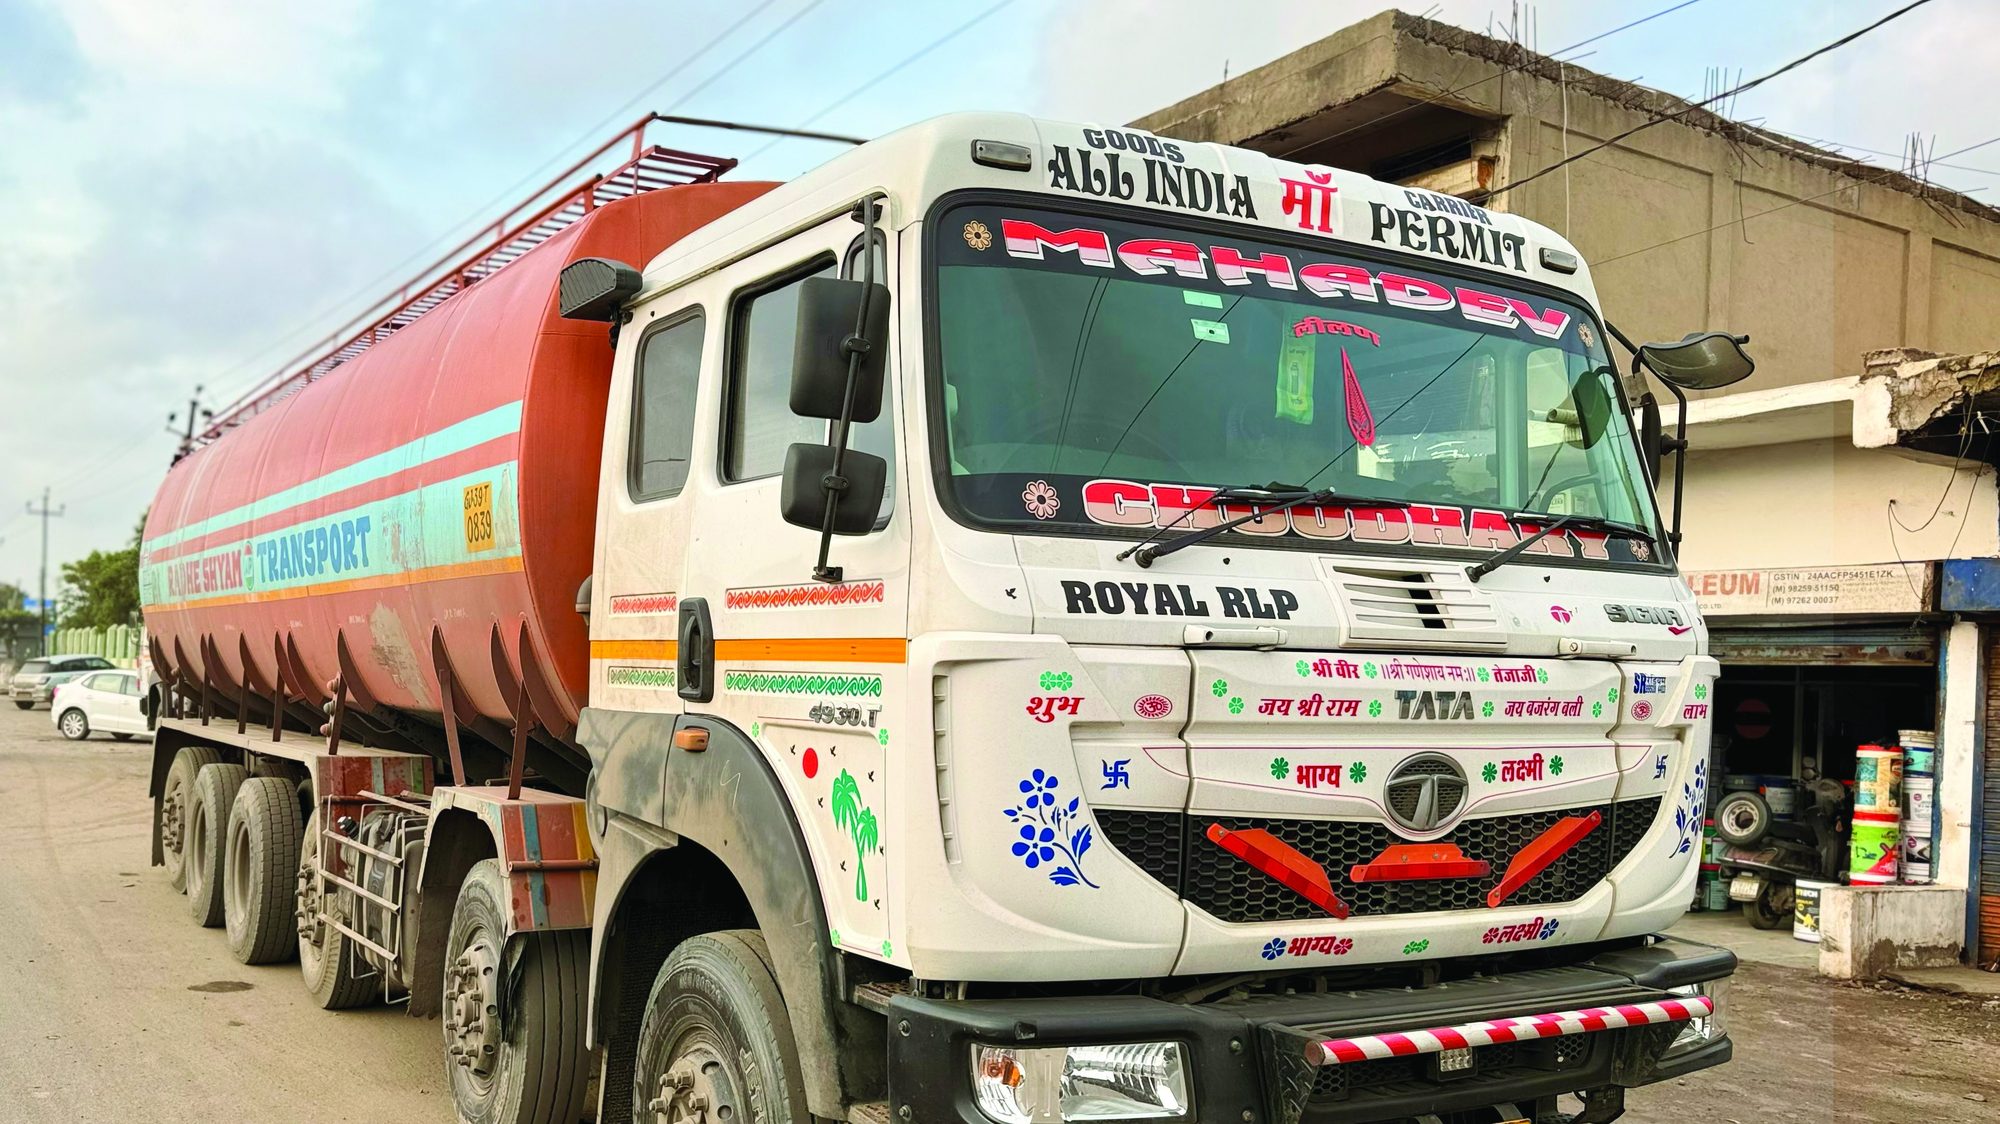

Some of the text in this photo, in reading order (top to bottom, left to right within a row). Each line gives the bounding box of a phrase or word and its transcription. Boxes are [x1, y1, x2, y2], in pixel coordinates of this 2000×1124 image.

[1083, 128, 1185, 163] GOODS
[1048, 144, 1258, 221] ALL INDIA
[1403, 190, 1493, 226] CARRIER
[1369, 201, 1528, 273] PERMIT
[1001, 218, 1571, 340] MAHADEV
[467, 510, 492, 543] 0839
[1081, 479, 1611, 561] CHOUDHARY
[256, 515, 372, 584] TRANSPORT
[168, 559, 201, 597] RADHE
[202, 549, 243, 593] SHYAM
[1773, 573, 1800, 581] GSTIN
[1061, 580, 1299, 620] ROYAL RLP
[1771, 597, 1785, 606] (M)
[1772, 585, 1786, 594] (M)
[1603, 603, 1685, 627] SIGNA
[1334, 659, 1361, 680] वीर
[1492, 664, 1538, 683] तेजाजी
[1633, 672, 1647, 694] SR
[808, 700, 883, 728] 4930.T
[1026, 696, 1085, 724] शुभ
[1258, 693, 1362, 717] जय श्री राम
[1394, 689, 1475, 720] TATA
[1504, 700, 1526, 718] जय
[1683, 703, 1709, 720] लाभ
[1296, 764, 1342, 789] भाग्य
[1501, 752, 1545, 783] लक्ष्मी
[1497, 916, 1545, 944] लक्ष्मी
[1287, 935, 1337, 957] भाग्य
